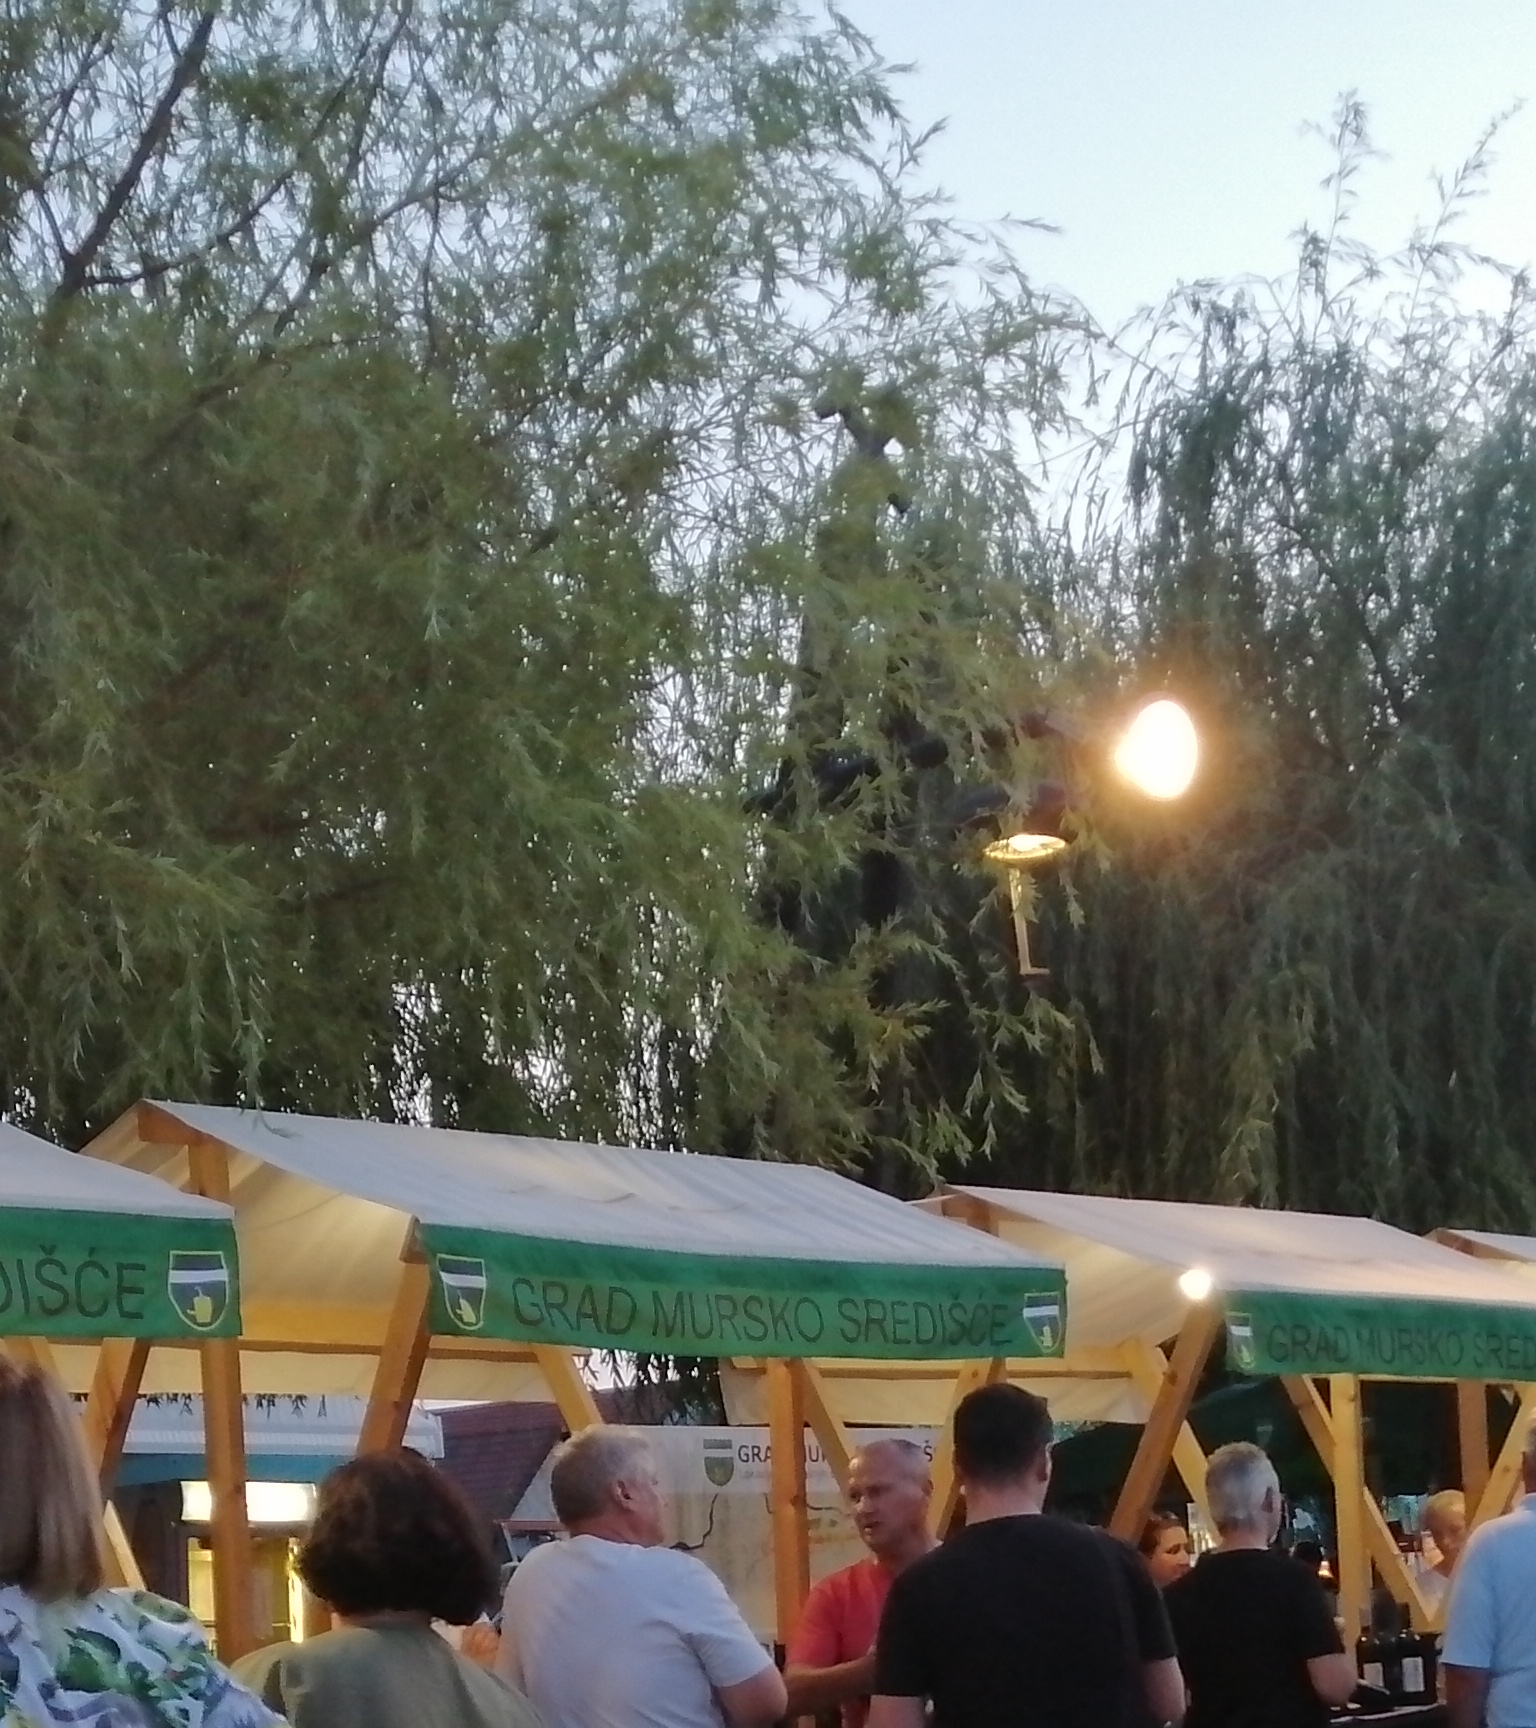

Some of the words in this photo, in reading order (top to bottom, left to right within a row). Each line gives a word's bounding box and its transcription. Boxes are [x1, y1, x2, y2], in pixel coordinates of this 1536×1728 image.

[511, 1277, 638, 1336] GRAD
[652, 1290, 825, 1344] MURSKO
[838, 1291, 1014, 1348] SREDIŠĆE
[1267, 1324, 1352, 1363] GRAD
[1357, 1325, 1463, 1367] MURSKO
